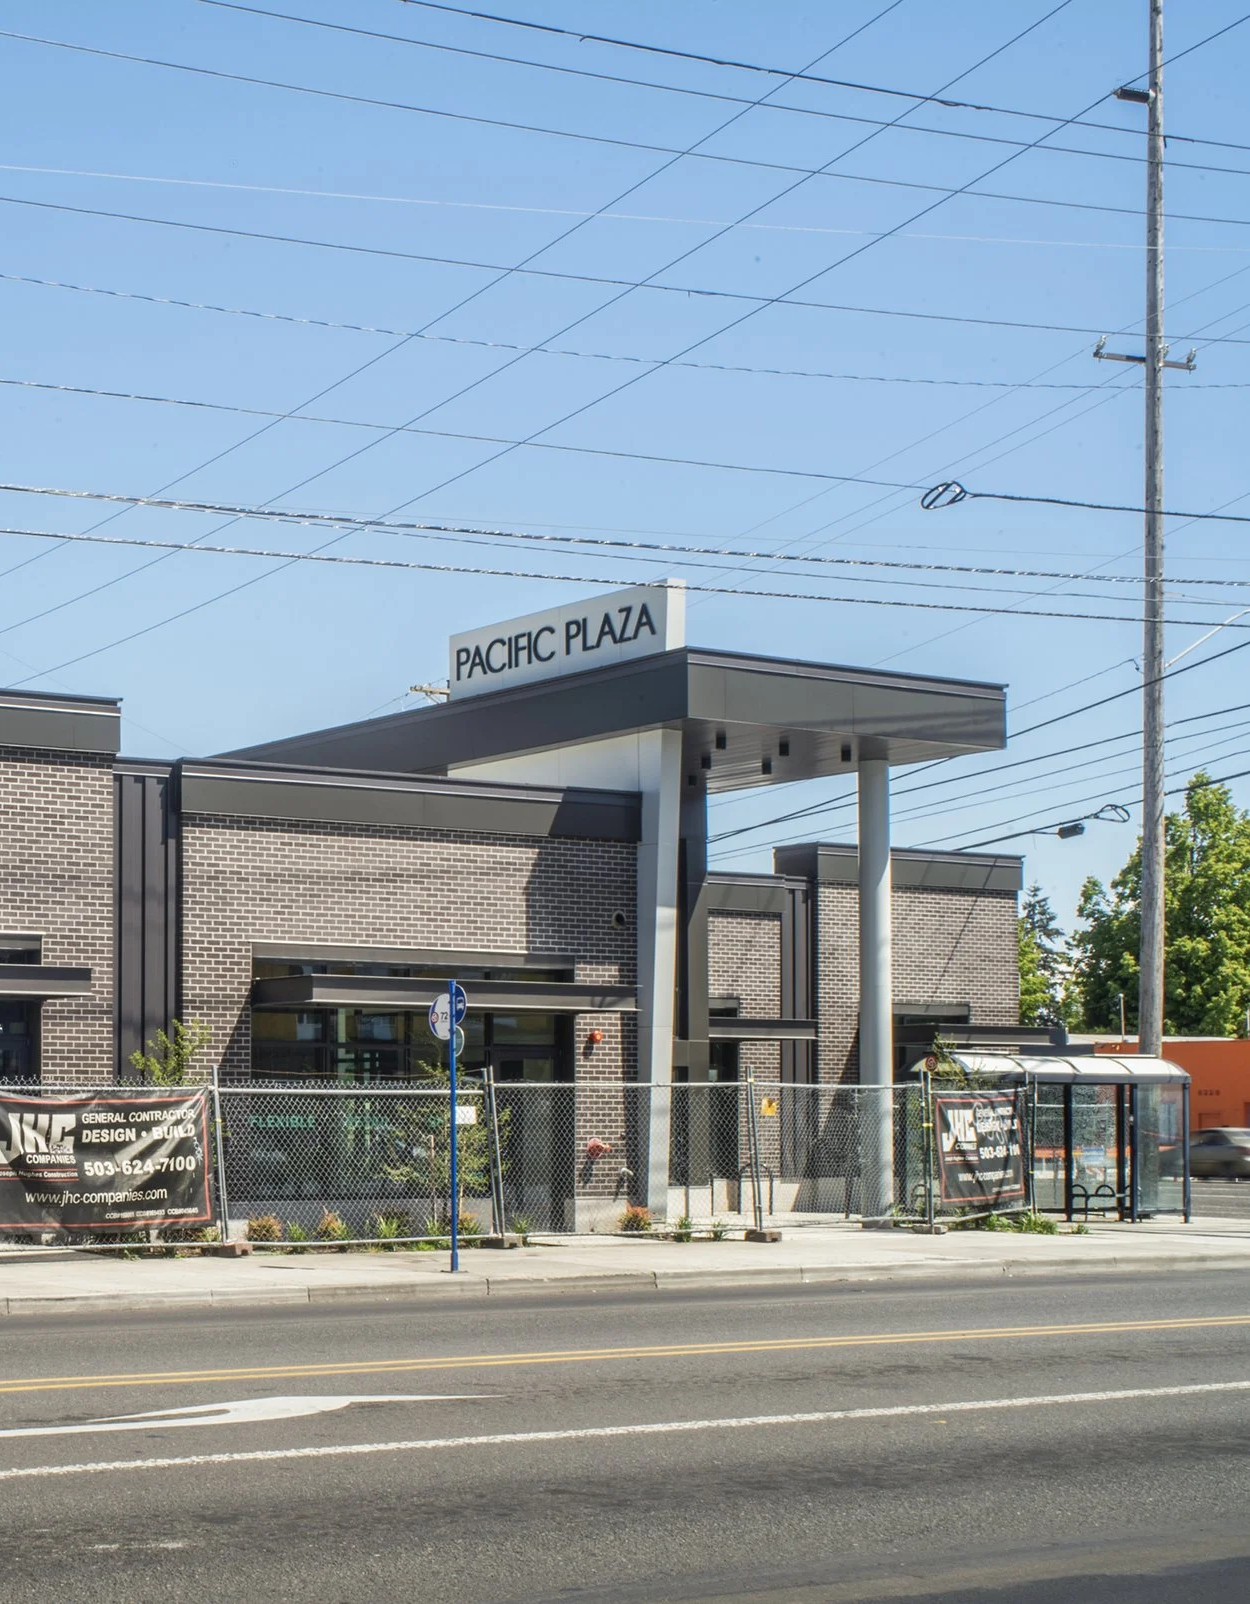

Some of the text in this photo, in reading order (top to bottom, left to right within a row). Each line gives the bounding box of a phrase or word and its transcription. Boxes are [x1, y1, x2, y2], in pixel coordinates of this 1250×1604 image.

[456, 603, 657, 682] PACIFIC PLAZA
[440, 1011, 449, 1020] 72
[82, 1109, 196, 1124] GENERAL CONTRACTOR
[82, 1124, 196, 1143] DESIGN BUILD
[26, 1154, 77, 1165] COMPANIES
[84, 1156, 196, 1177] 503-624-7100
[25, 1187, 168, 1206] www.jhc-companies.com
